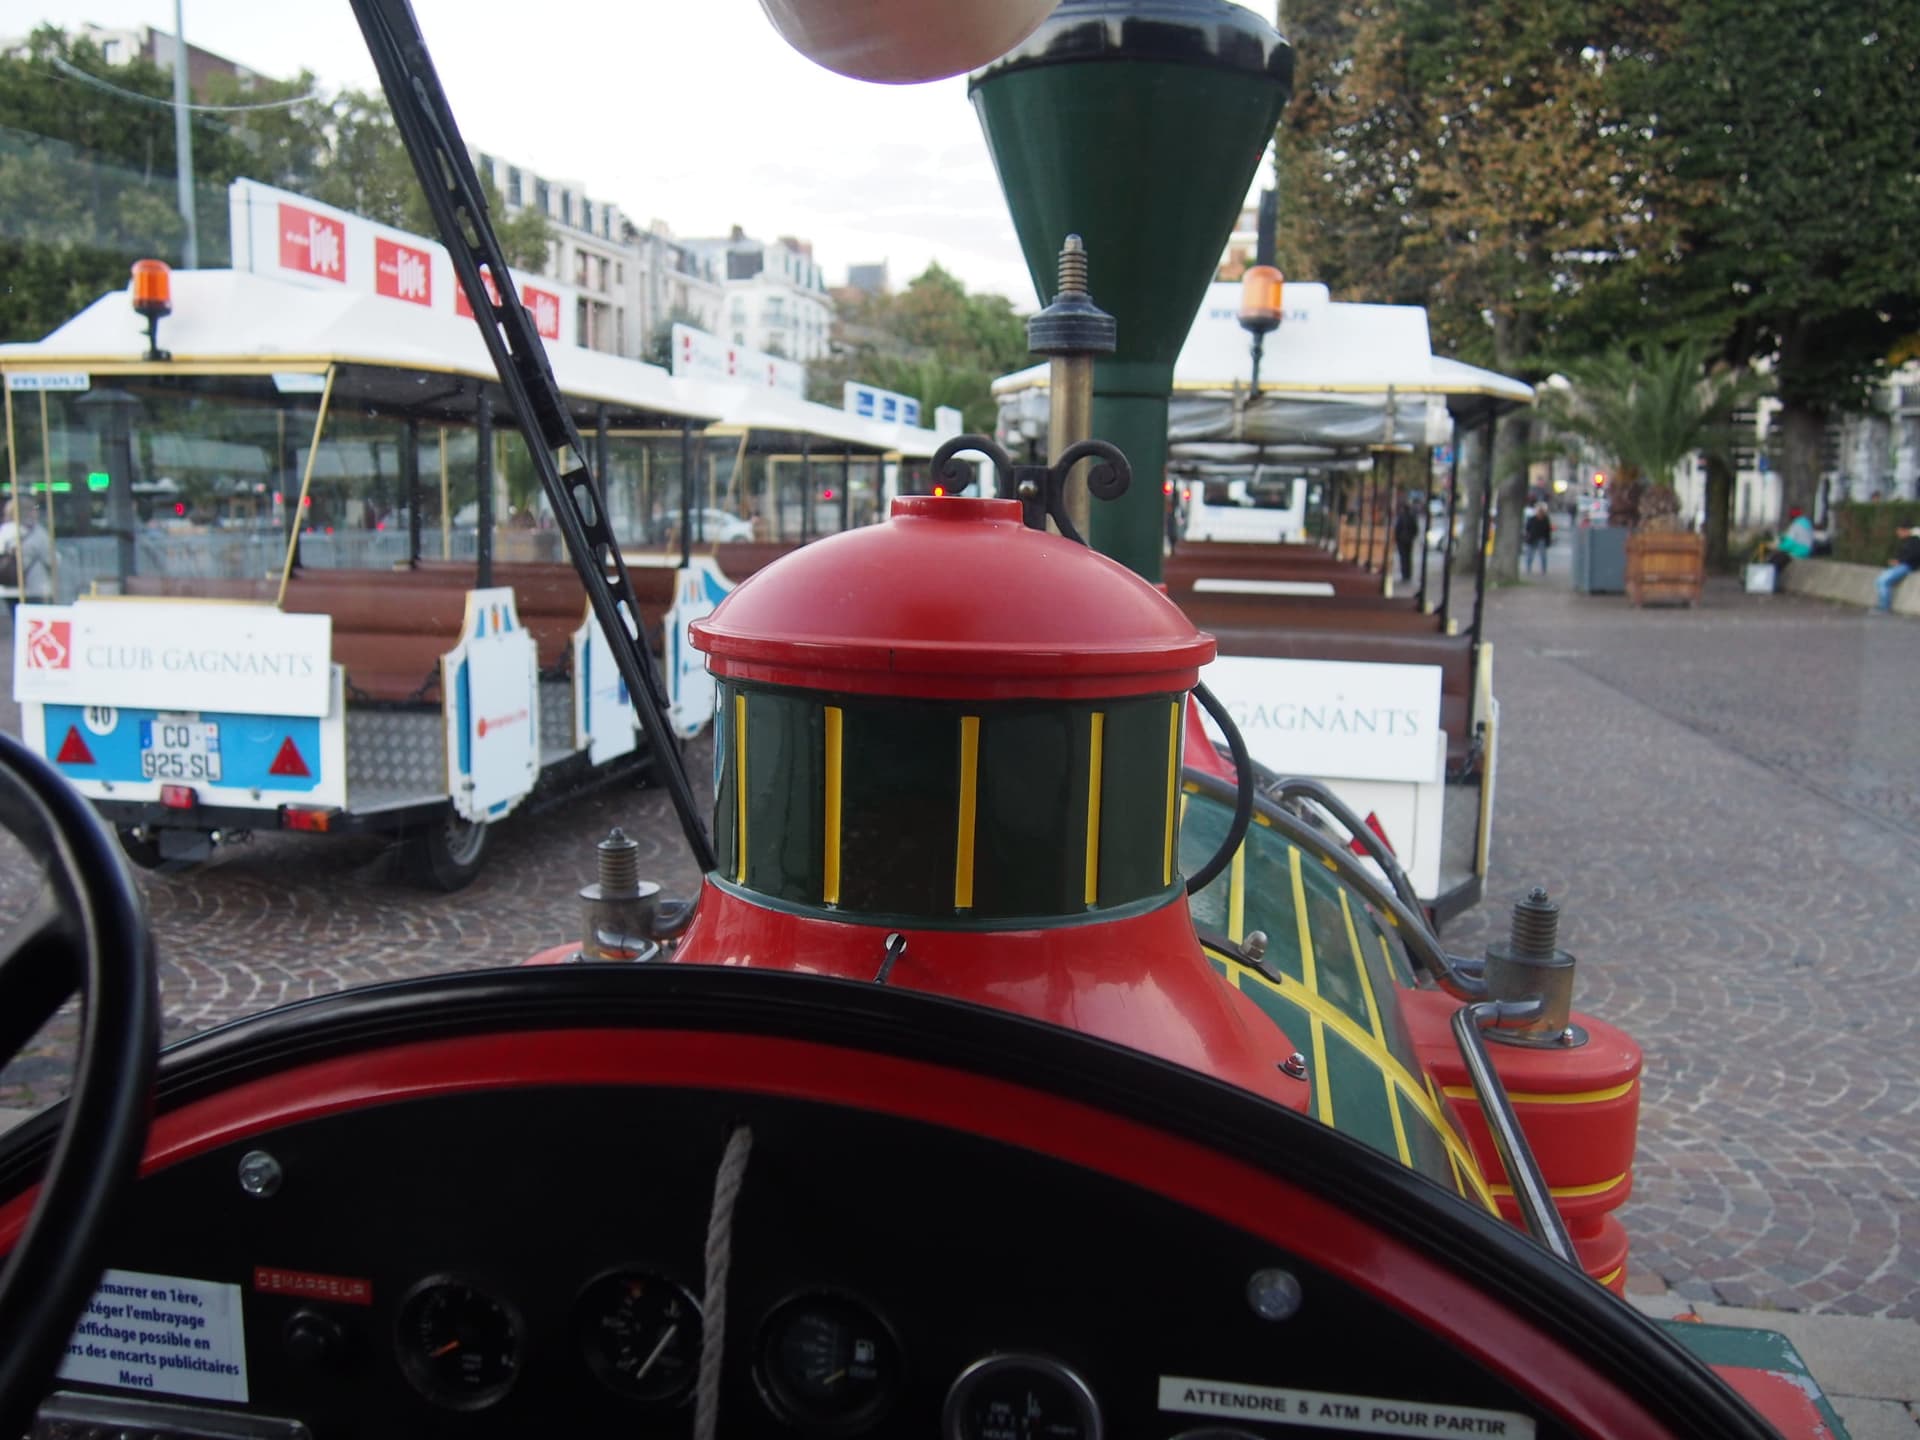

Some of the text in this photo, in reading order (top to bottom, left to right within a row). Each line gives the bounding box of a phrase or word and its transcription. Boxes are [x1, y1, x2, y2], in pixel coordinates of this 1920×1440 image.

[86, 643, 313, 678] CLUB GAGNANTS
[1228, 700, 1420, 737] GAGNANTS
[151, 1288, 167, 1301] en
[170, 1287, 204, 1308] 1ère,
[126, 1304, 206, 1330] l'embrayage
[78, 1321, 211, 1350] affichage possible en
[86, 1343, 107, 1359] des
[109, 1349, 157, 1366] encarts
[159, 1353, 240, 1376] publicitaires
[119, 1369, 154, 1387] Merci
[1183, 1387, 1508, 1436] ATTENDRE 5 ATM POUR PARTIR
